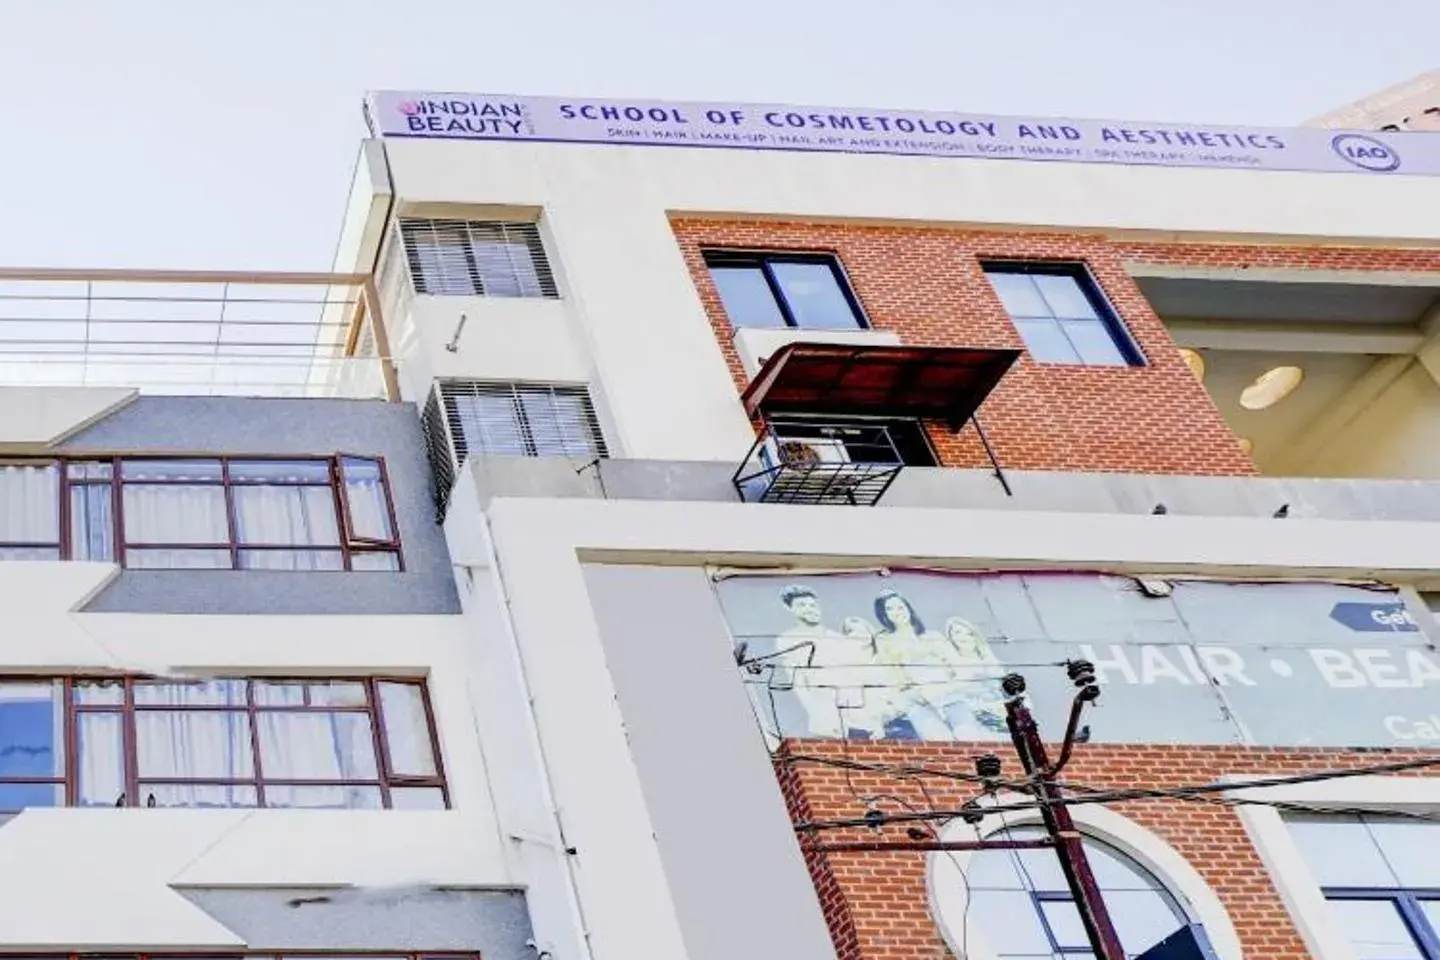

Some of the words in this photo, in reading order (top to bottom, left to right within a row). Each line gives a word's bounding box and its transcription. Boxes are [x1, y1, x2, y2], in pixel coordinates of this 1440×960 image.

[421, 101, 522, 117] INDIAN
[407, 116, 522, 134] BEAUTY
[559, 104, 689, 124] SCHOOL
[706, 110, 745, 126] OF
[764, 111, 997, 137] COSMETOLOGY
[1018, 124, 1081, 141] AND
[1101, 127, 1286, 149] AESTHETICS
[1346, 146, 1388, 158] IAO
[1078, 644, 1258, 687] HAIR
